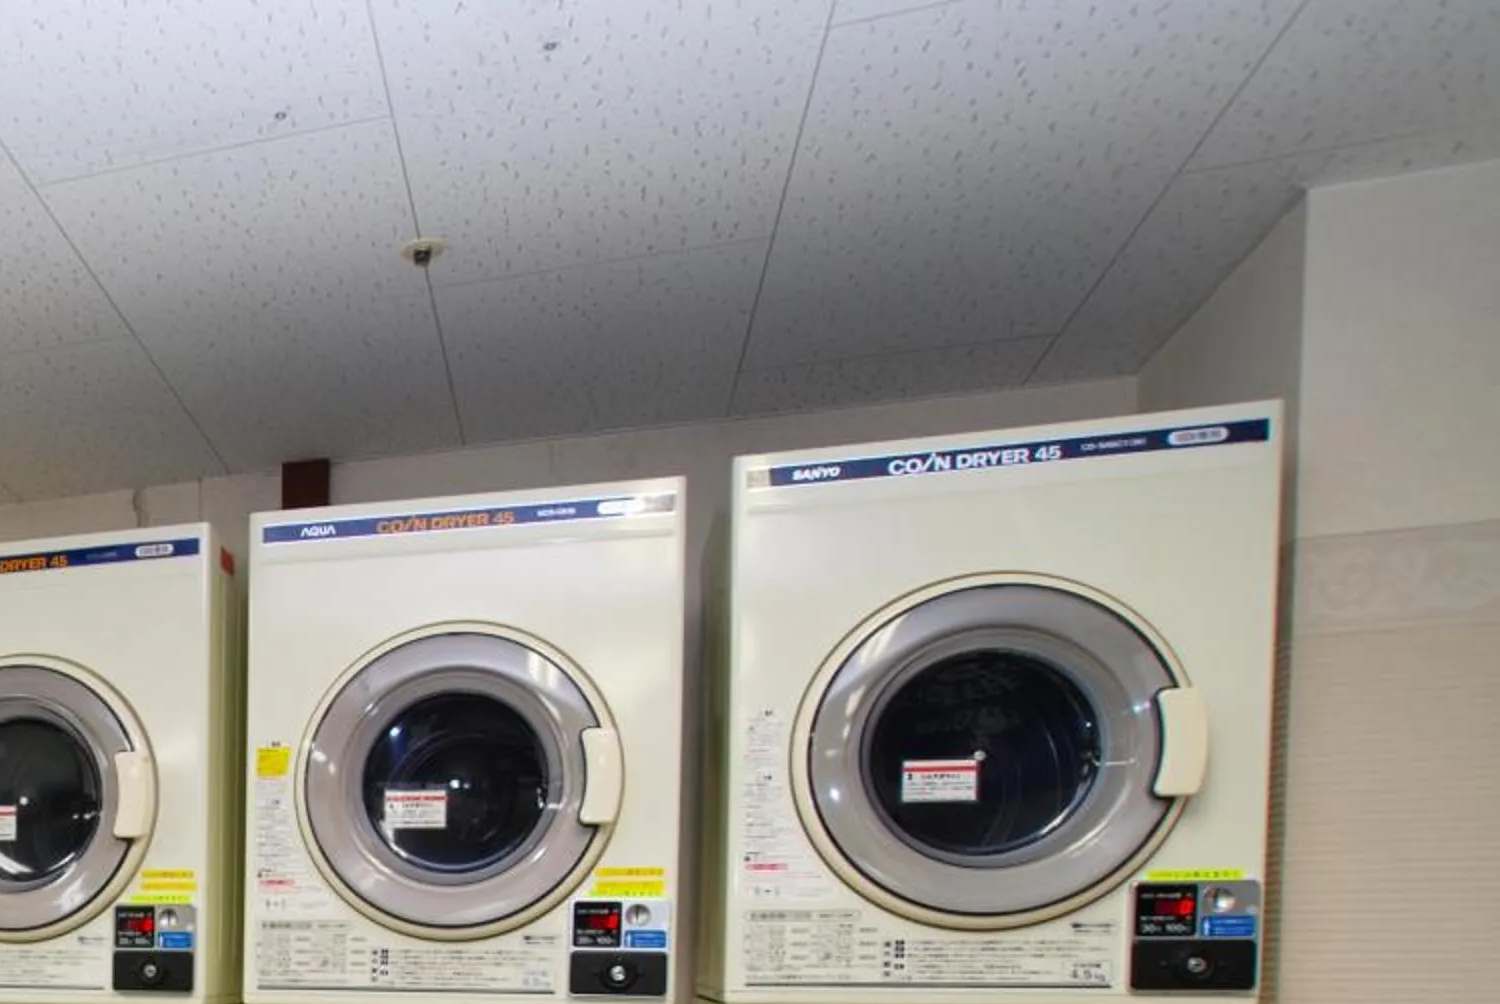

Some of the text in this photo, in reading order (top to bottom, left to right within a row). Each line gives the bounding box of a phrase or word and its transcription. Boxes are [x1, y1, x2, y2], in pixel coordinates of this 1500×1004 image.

[791, 466, 841, 481] SANYO
[956, 448, 1030, 470] DRYER
[1035, 445, 1062, 461] 45
[300, 524, 337, 538] AQUA
[432, 512, 489, 529] DRYER
[494, 511, 515, 525] 45
[0, 556, 47, 573] DRYER
[50, 554, 69, 568] 45
